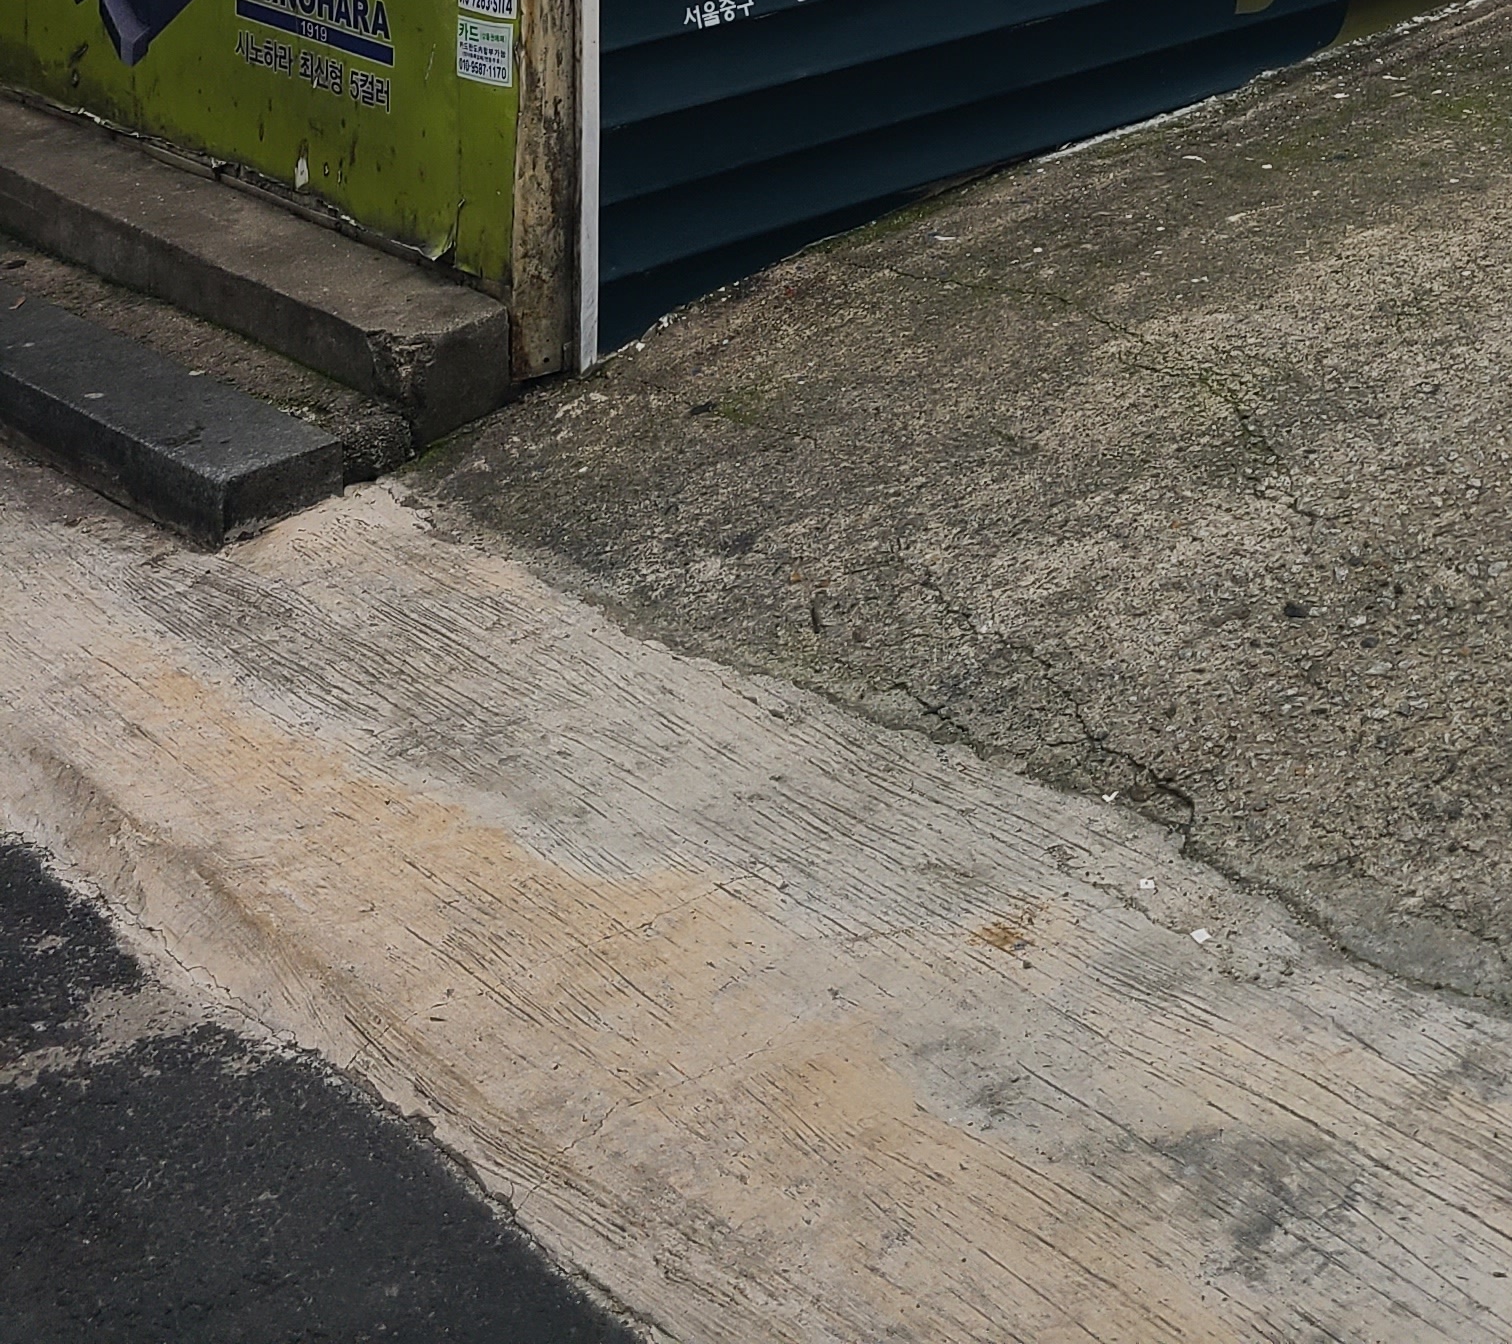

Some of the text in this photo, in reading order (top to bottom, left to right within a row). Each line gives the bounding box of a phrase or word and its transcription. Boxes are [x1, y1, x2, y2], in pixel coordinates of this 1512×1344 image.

[300, 20, 328, 42] 1919
[458, 23, 480, 42] 카드
[234, 30, 391, 114] 시노하라 최신형 5컬러
